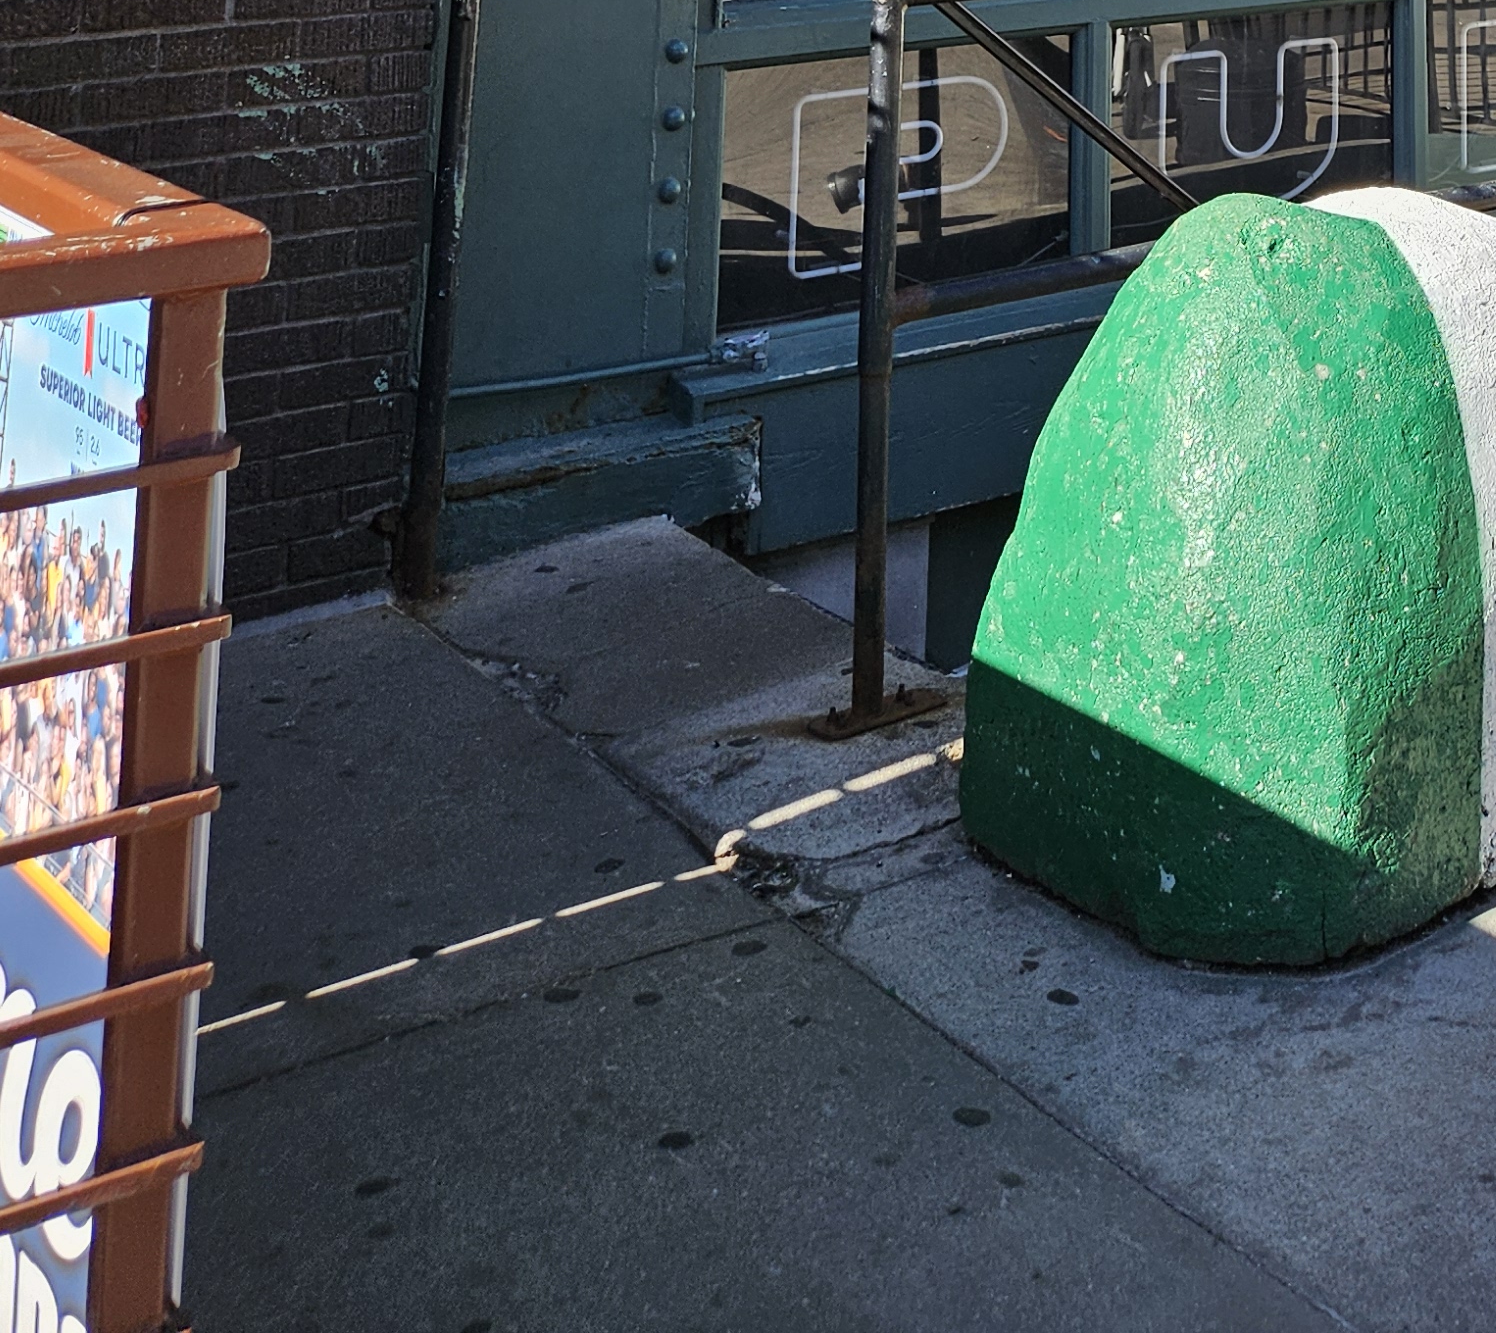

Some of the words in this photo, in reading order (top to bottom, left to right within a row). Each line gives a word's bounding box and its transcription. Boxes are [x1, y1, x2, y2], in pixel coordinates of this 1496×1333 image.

[98, 321, 145, 388] ULTR
[40, 363, 86, 414] SUPERIOR
[87, 391, 116, 432] LIGHT
